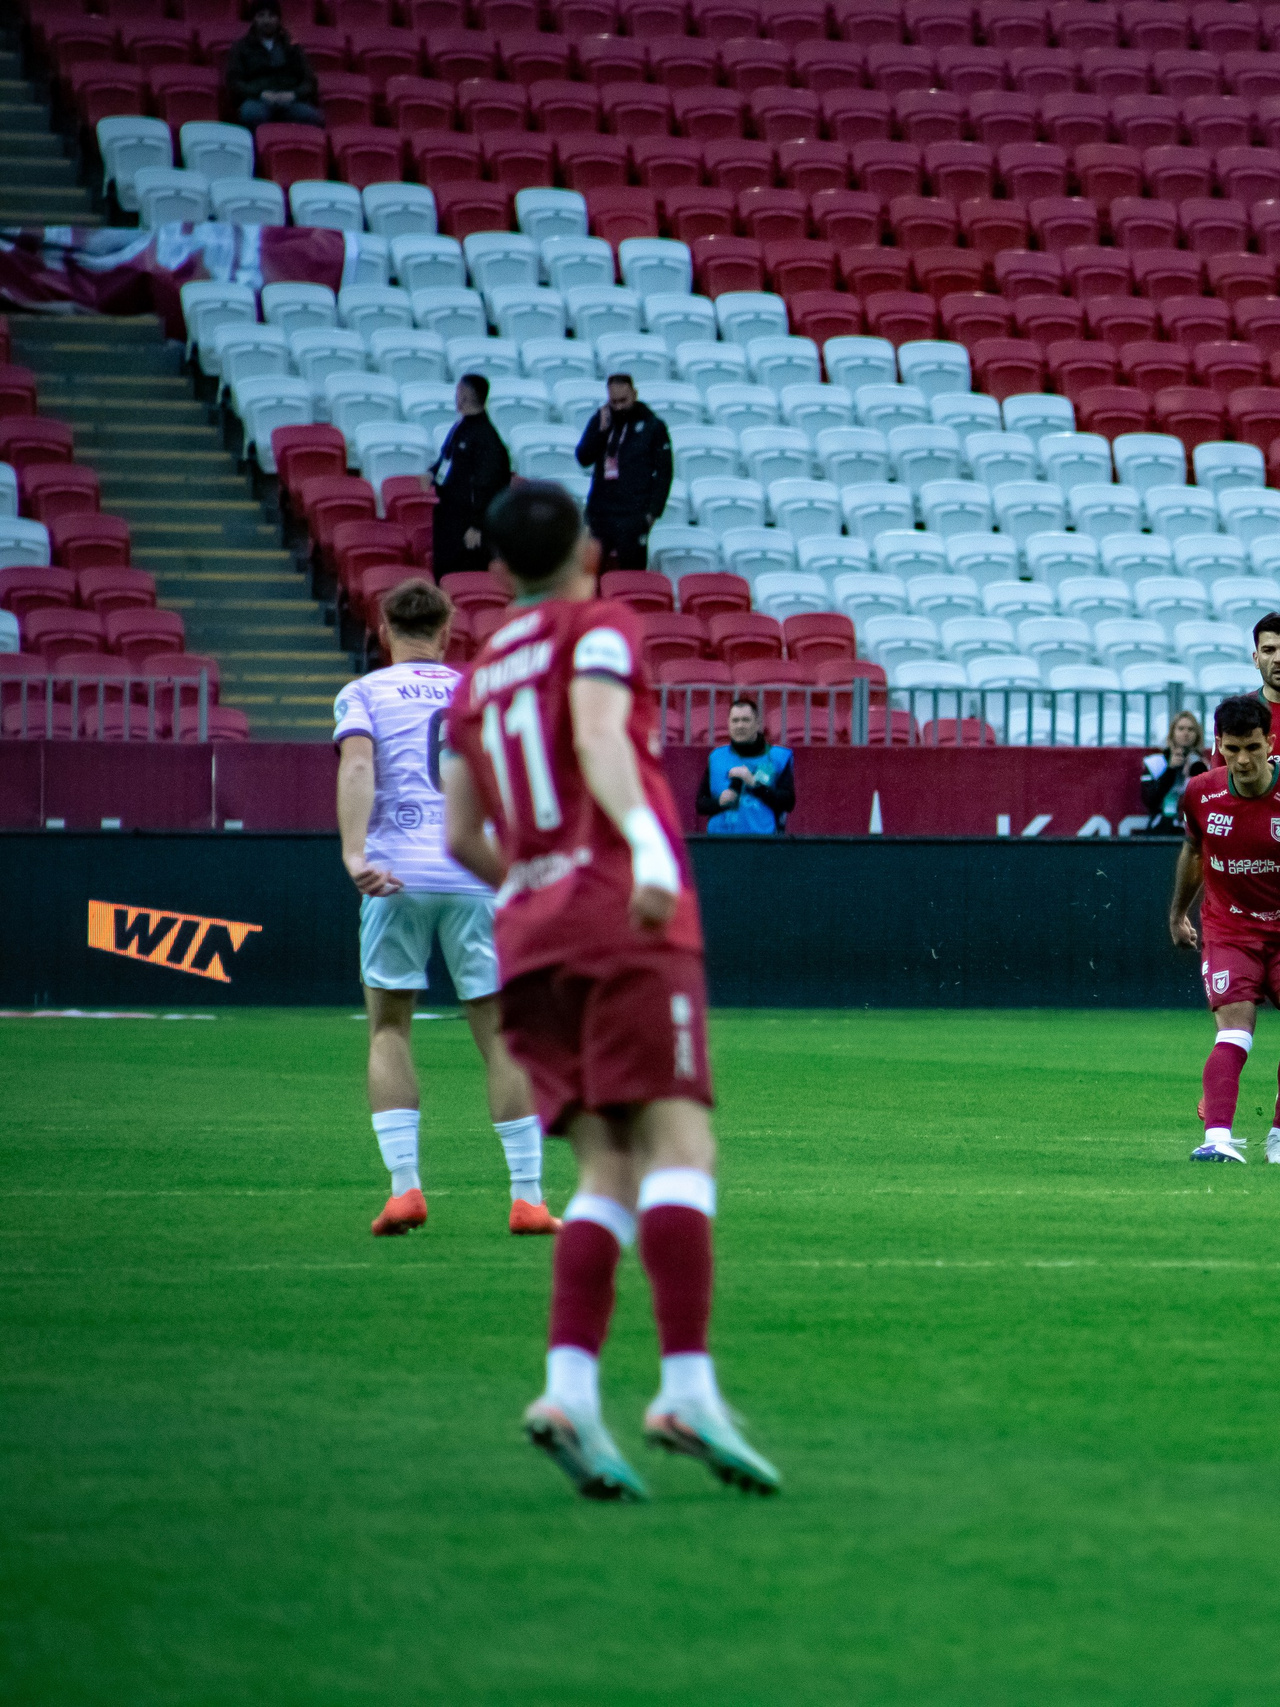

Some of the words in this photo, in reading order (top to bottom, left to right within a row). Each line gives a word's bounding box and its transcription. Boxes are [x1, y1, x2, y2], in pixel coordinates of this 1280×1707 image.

[481, 685, 563, 832] 11
[1207, 813, 1233, 826] FON
[1206, 824, 1233, 837] BET
[1228, 859, 1275, 867] КАЗАНЬ
[113, 908, 251, 980] WIN
